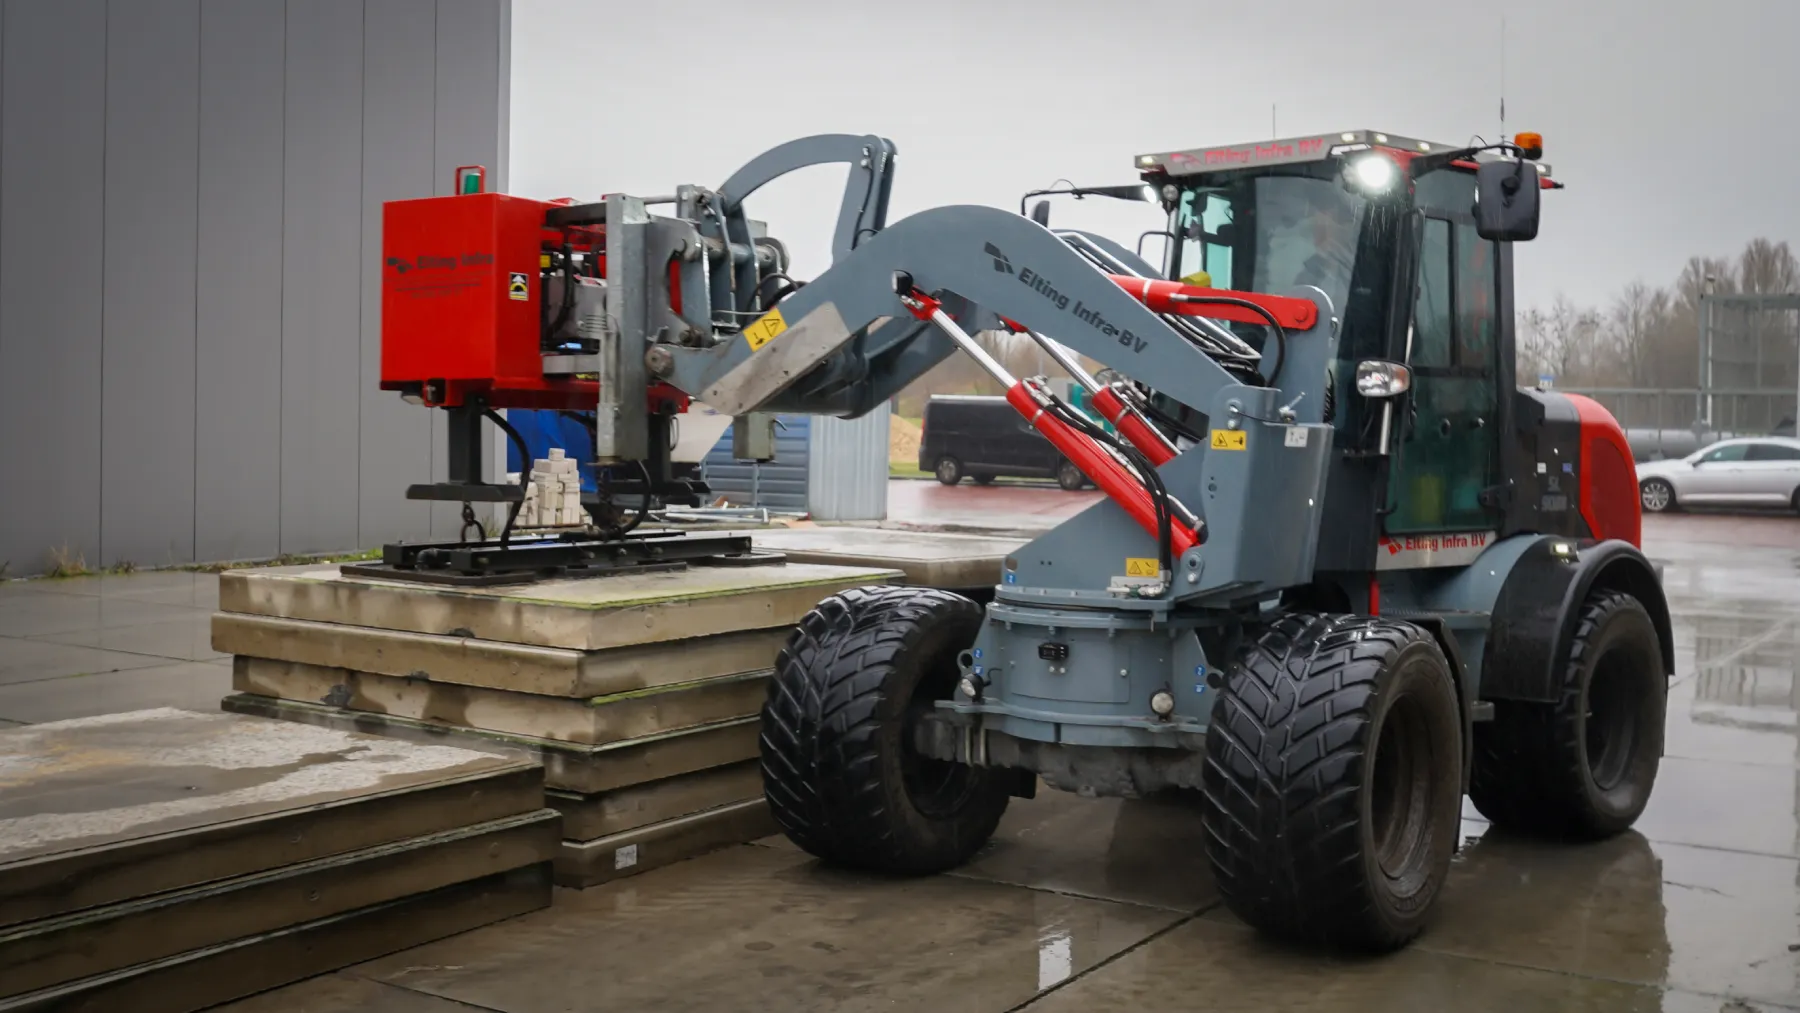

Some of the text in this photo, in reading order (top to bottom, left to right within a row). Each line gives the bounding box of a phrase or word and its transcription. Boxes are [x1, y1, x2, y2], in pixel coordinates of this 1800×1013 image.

[1256, 143, 1293, 161] Infra
[1299, 137, 1324, 155] BV
[417, 255, 456, 271] Elting
[1019, 266, 1148, 354] Elting Infra BV
[1406, 532, 1486, 552] Elting Infra BV
